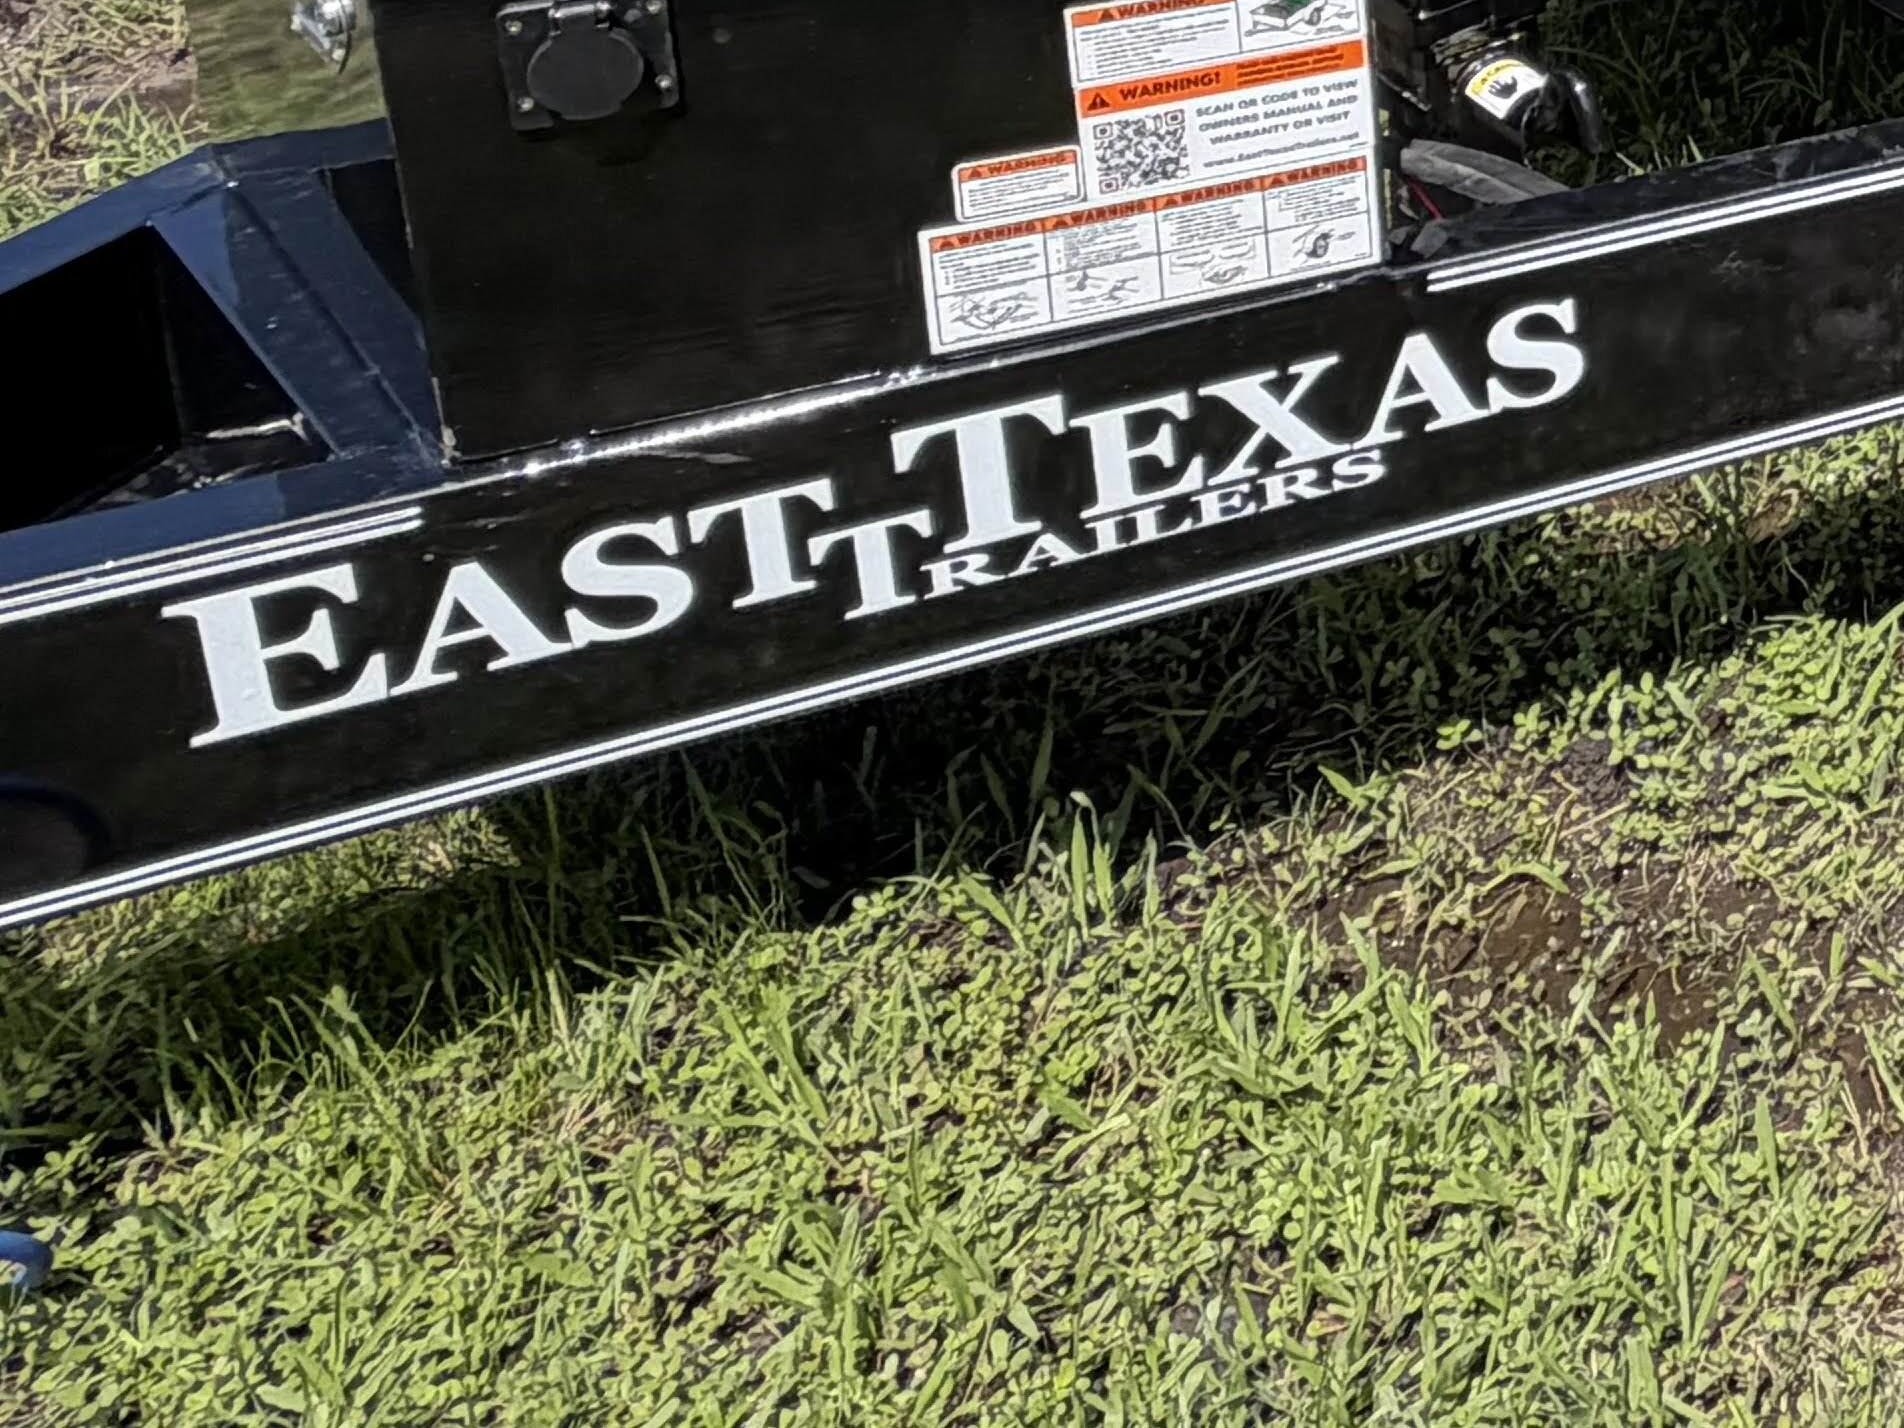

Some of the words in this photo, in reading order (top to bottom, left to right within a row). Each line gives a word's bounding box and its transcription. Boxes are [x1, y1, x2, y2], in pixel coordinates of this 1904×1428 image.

[1119, 71, 1221, 101] WARNING!
[1196, 102, 1234, 118] SCAN
[1238, 98, 1258, 110] QR
[1261, 90, 1298, 105] CODE
[1302, 86, 1320, 97] TO
[1323, 78, 1358, 93] VIEW
[1199, 112, 1260, 132] OWNERS
[1263, 100, 1323, 120] MANUAL
[1327, 94, 1359, 108] AND
[1209, 122, 1290, 145] WARRANTY
[1292, 118, 1313, 130] OR
[1316, 110, 1351, 125] VISIT
[1285, 158, 1359, 183] WARNING
[1179, 178, 1260, 204] WARNING
[1069, 200, 1148, 225] WARNING
[957, 222, 1038, 245] WARNING
[161, 478, 835, 748] EAST
[890, 297, 1585, 554] TEXAS
[807, 448, 1387, 621] TRAILERS
